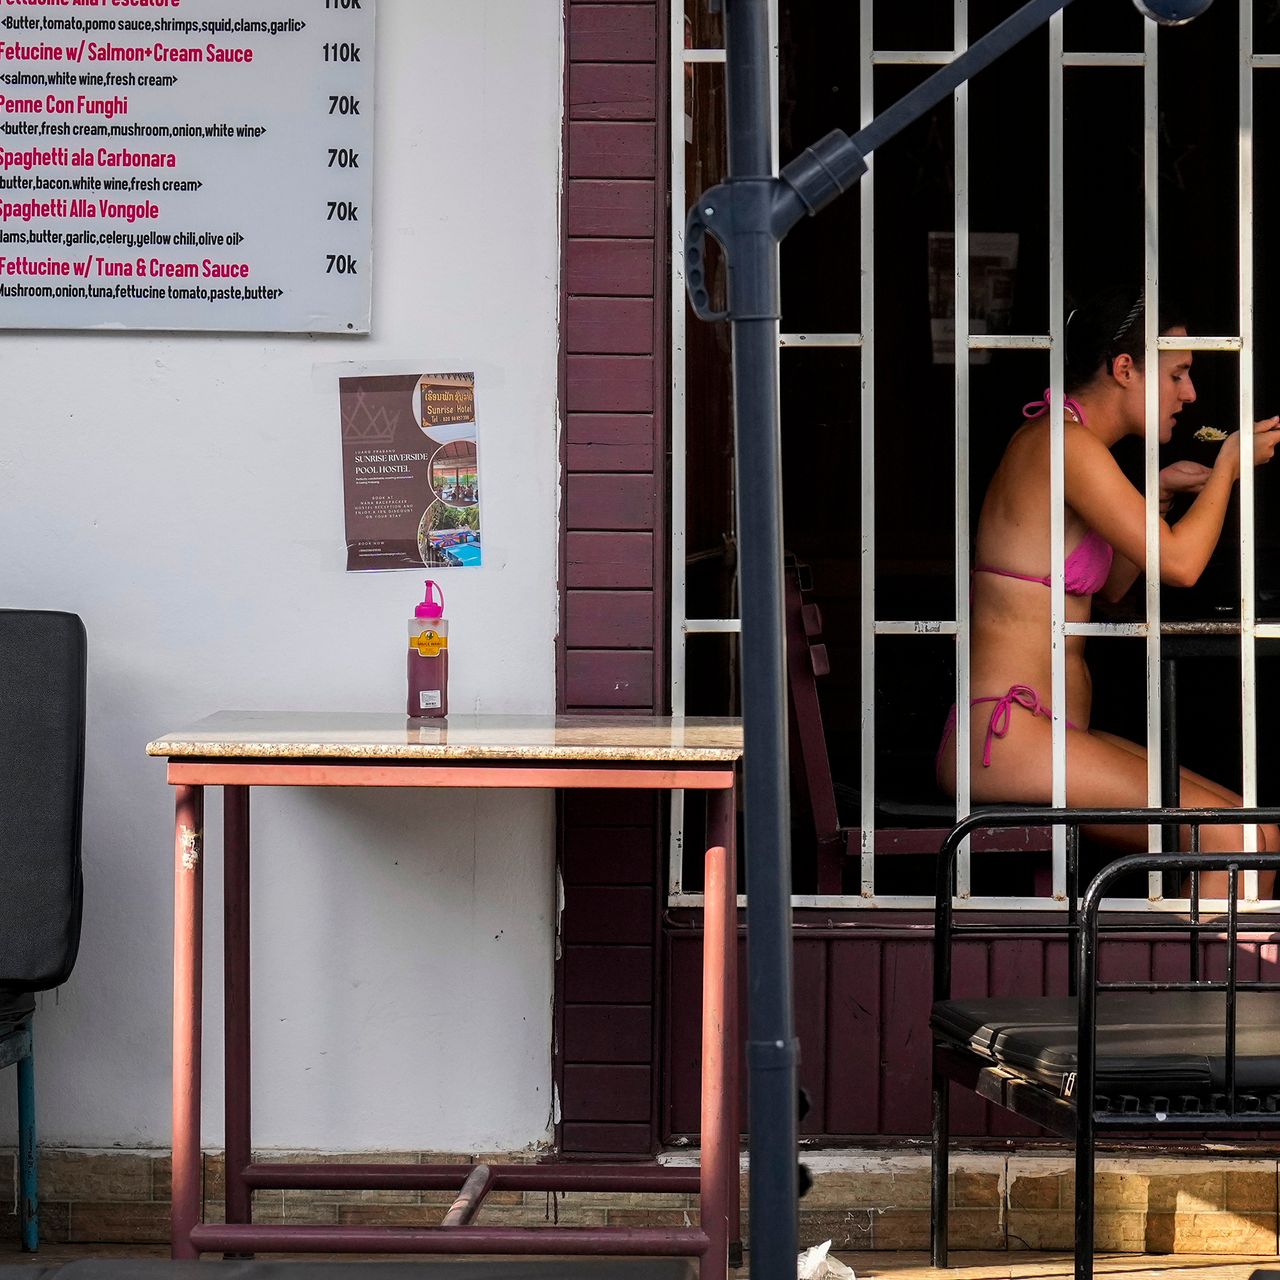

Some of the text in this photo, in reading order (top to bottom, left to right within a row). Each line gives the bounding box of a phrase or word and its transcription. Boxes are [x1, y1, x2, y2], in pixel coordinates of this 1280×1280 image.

[46, 95, 74, 113] Con
[77, 96, 127, 119] Funghi
[329, 96, 360, 115] 70k
[70, 199, 96, 218] Alla
[99, 199, 159, 223] Vongole
[327, 202, 358, 221] 70k
[427, 404, 472, 415] Sunrise Hotel
[355, 452, 429, 464] SUNRISE RIVERSIDE
[355, 464, 411, 475] POOL HOSTEL
